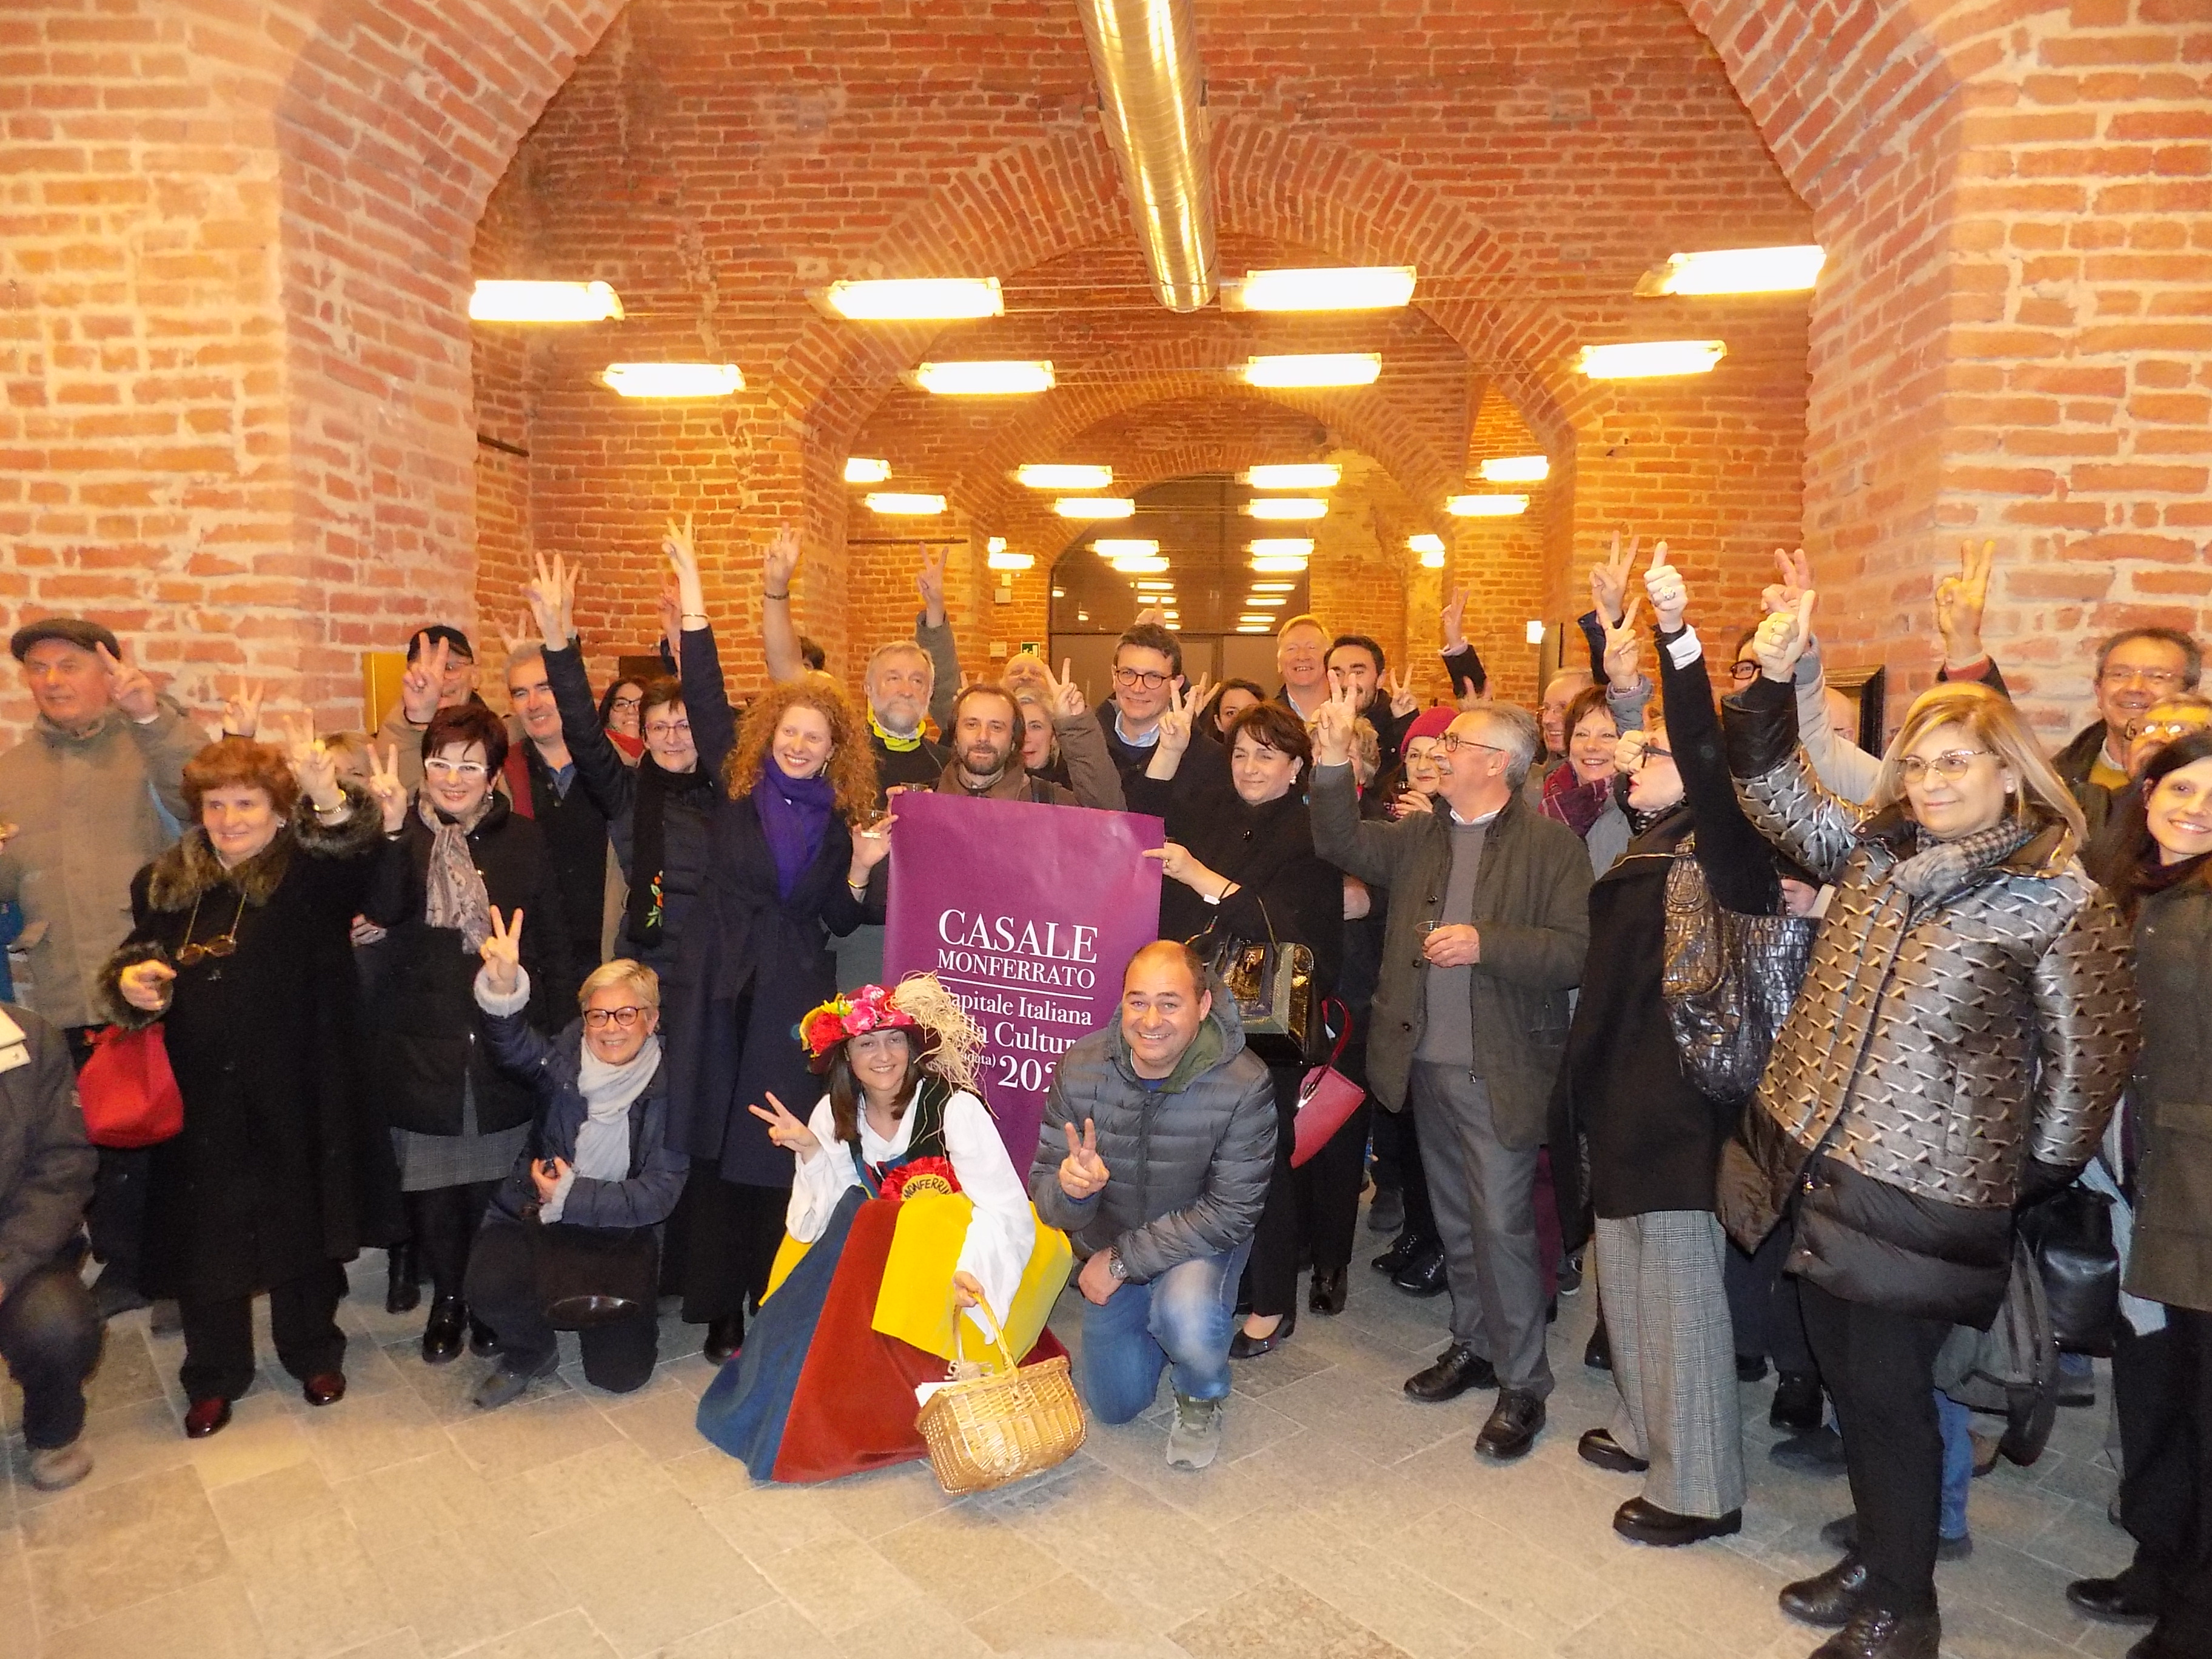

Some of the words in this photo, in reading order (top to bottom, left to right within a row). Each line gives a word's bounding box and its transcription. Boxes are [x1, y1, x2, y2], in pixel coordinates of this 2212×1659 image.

[938, 908, 1098, 964] CASALE
[937, 948, 1096, 990] MONFERRATO
[1017, 996, 1093, 1026] Italiana
[994, 1021, 1077, 1054] Cultur
[903, 1178, 952, 1200] MONFERRIN
